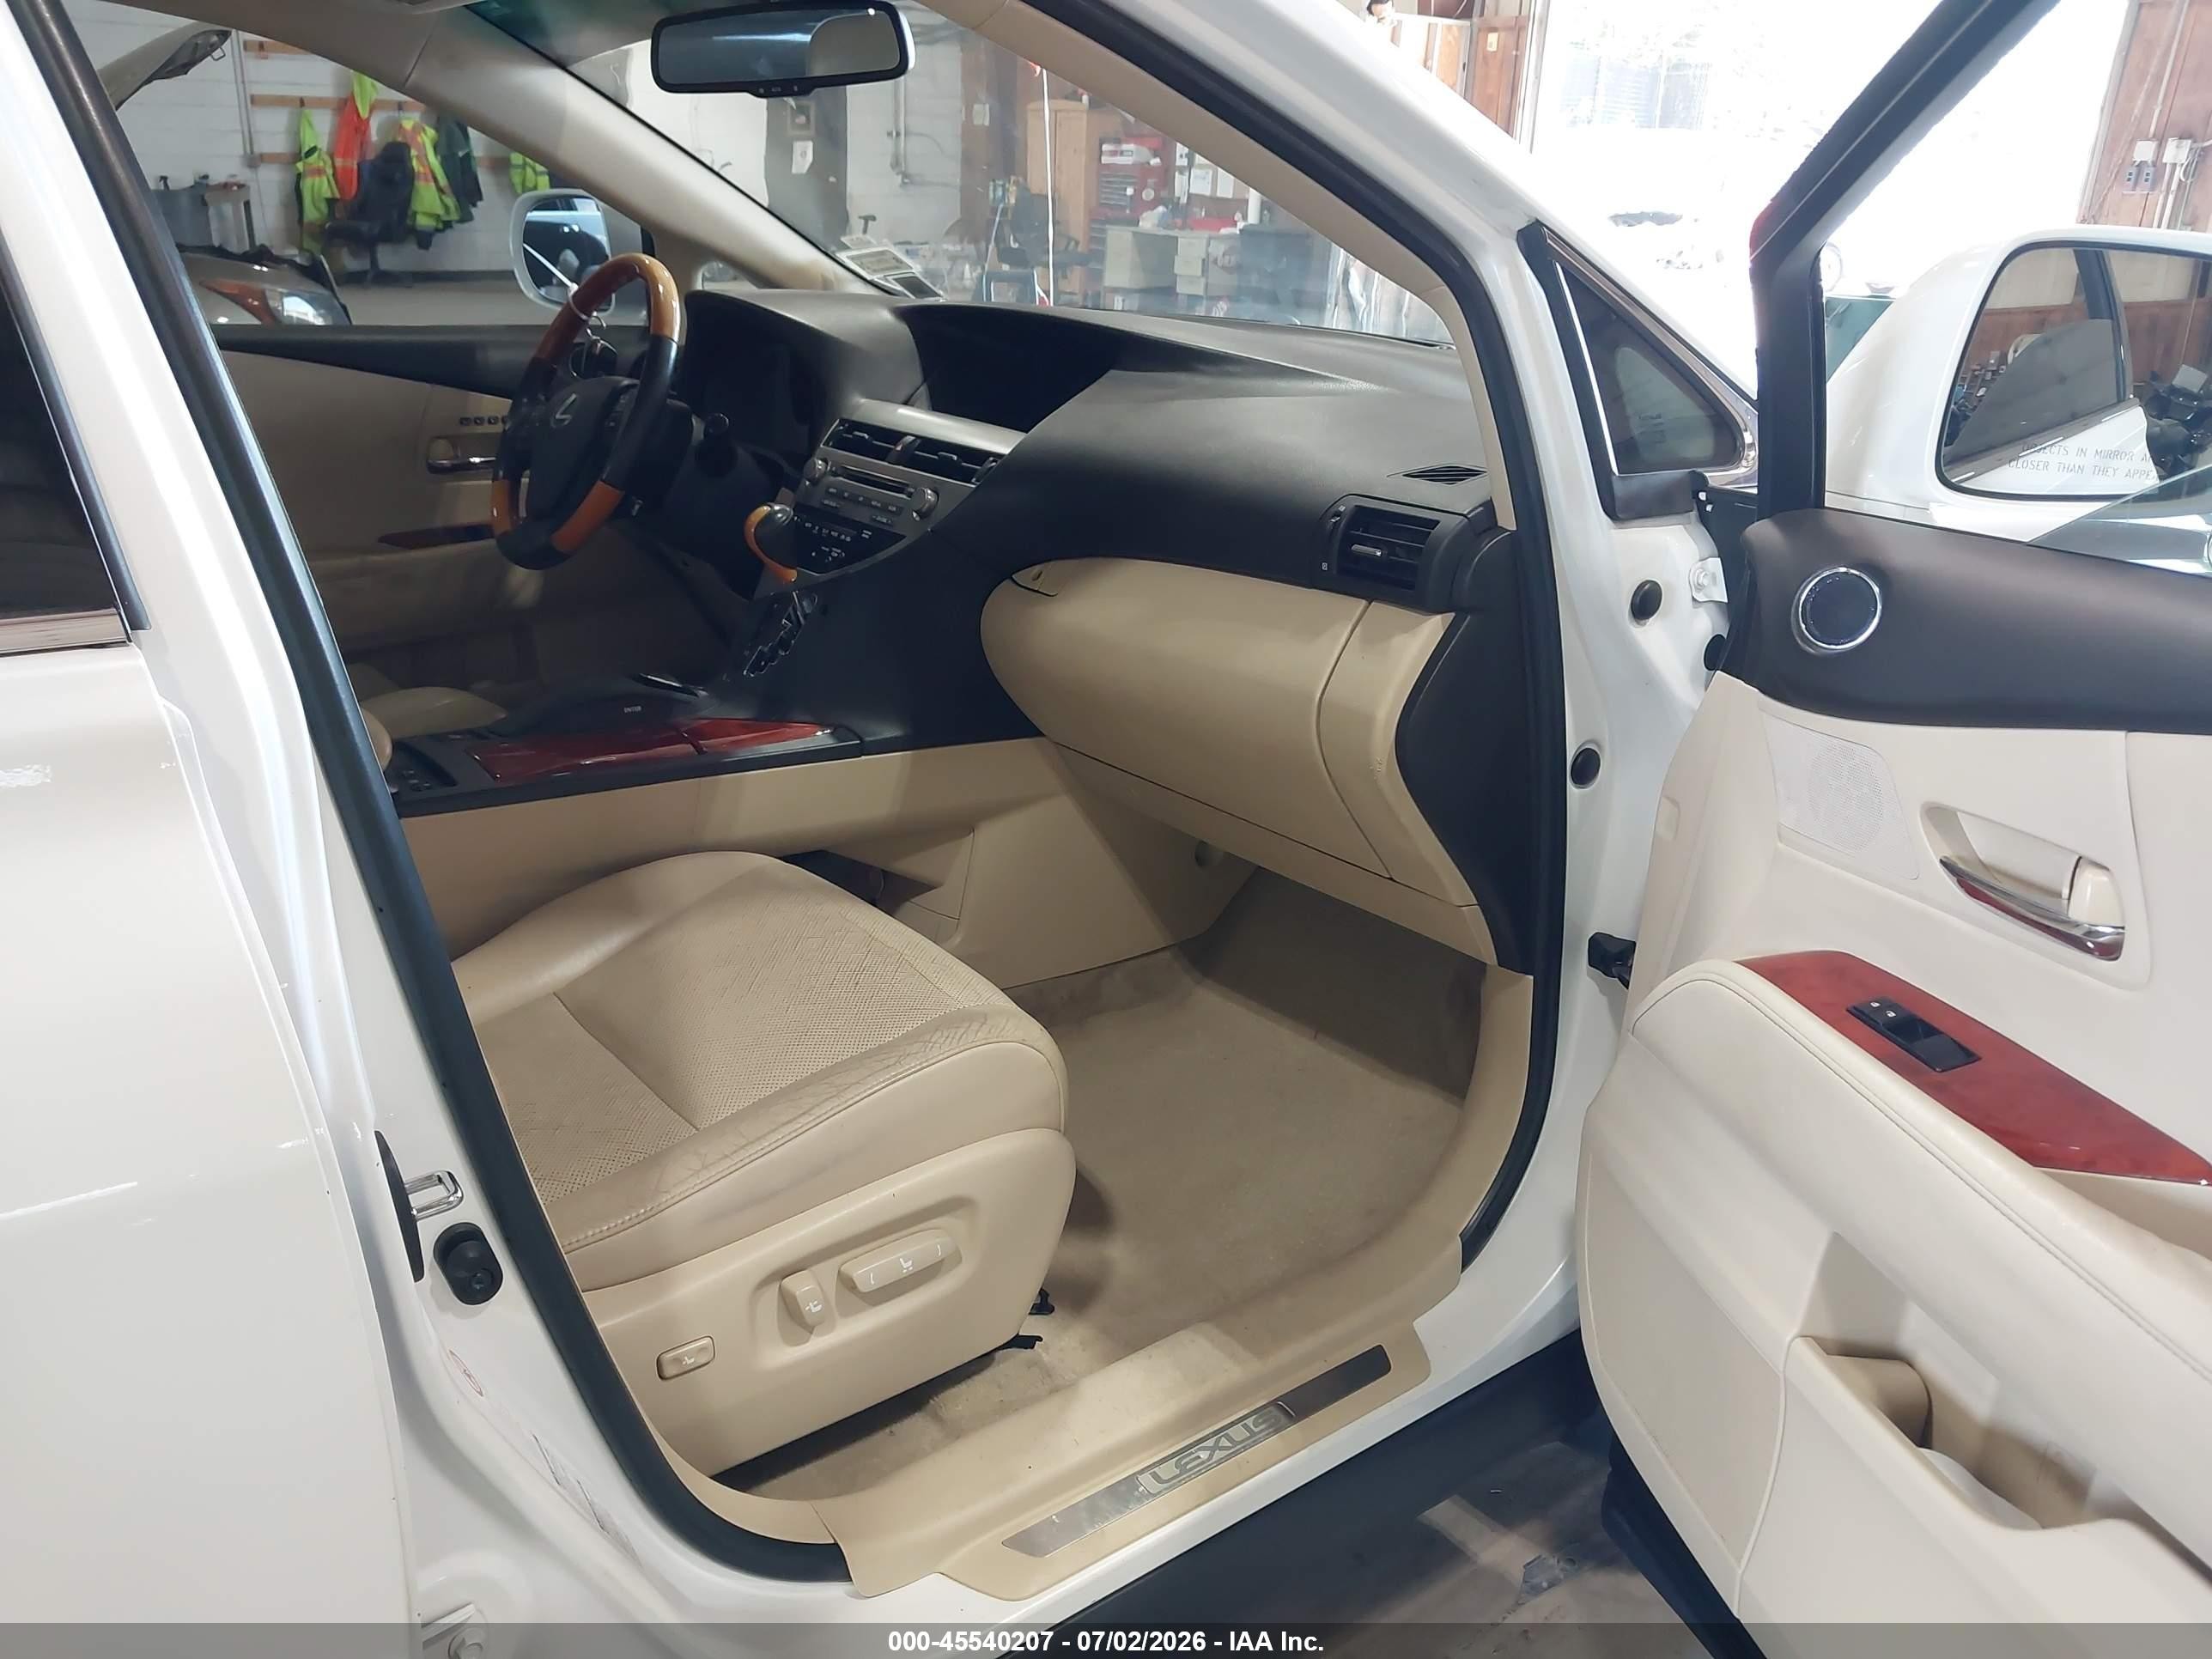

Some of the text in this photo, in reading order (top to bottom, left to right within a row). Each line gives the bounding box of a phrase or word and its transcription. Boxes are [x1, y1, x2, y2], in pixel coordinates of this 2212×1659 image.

[2075, 447, 2087, 457] IN
[2094, 448, 2135, 460] MIRROR
[2008, 459, 2050, 471] CLOSER
[2057, 462, 2086, 475] THAN
[2093, 465, 2120, 477] THEY
[1149, 1408, 1282, 1485] LEXUS
